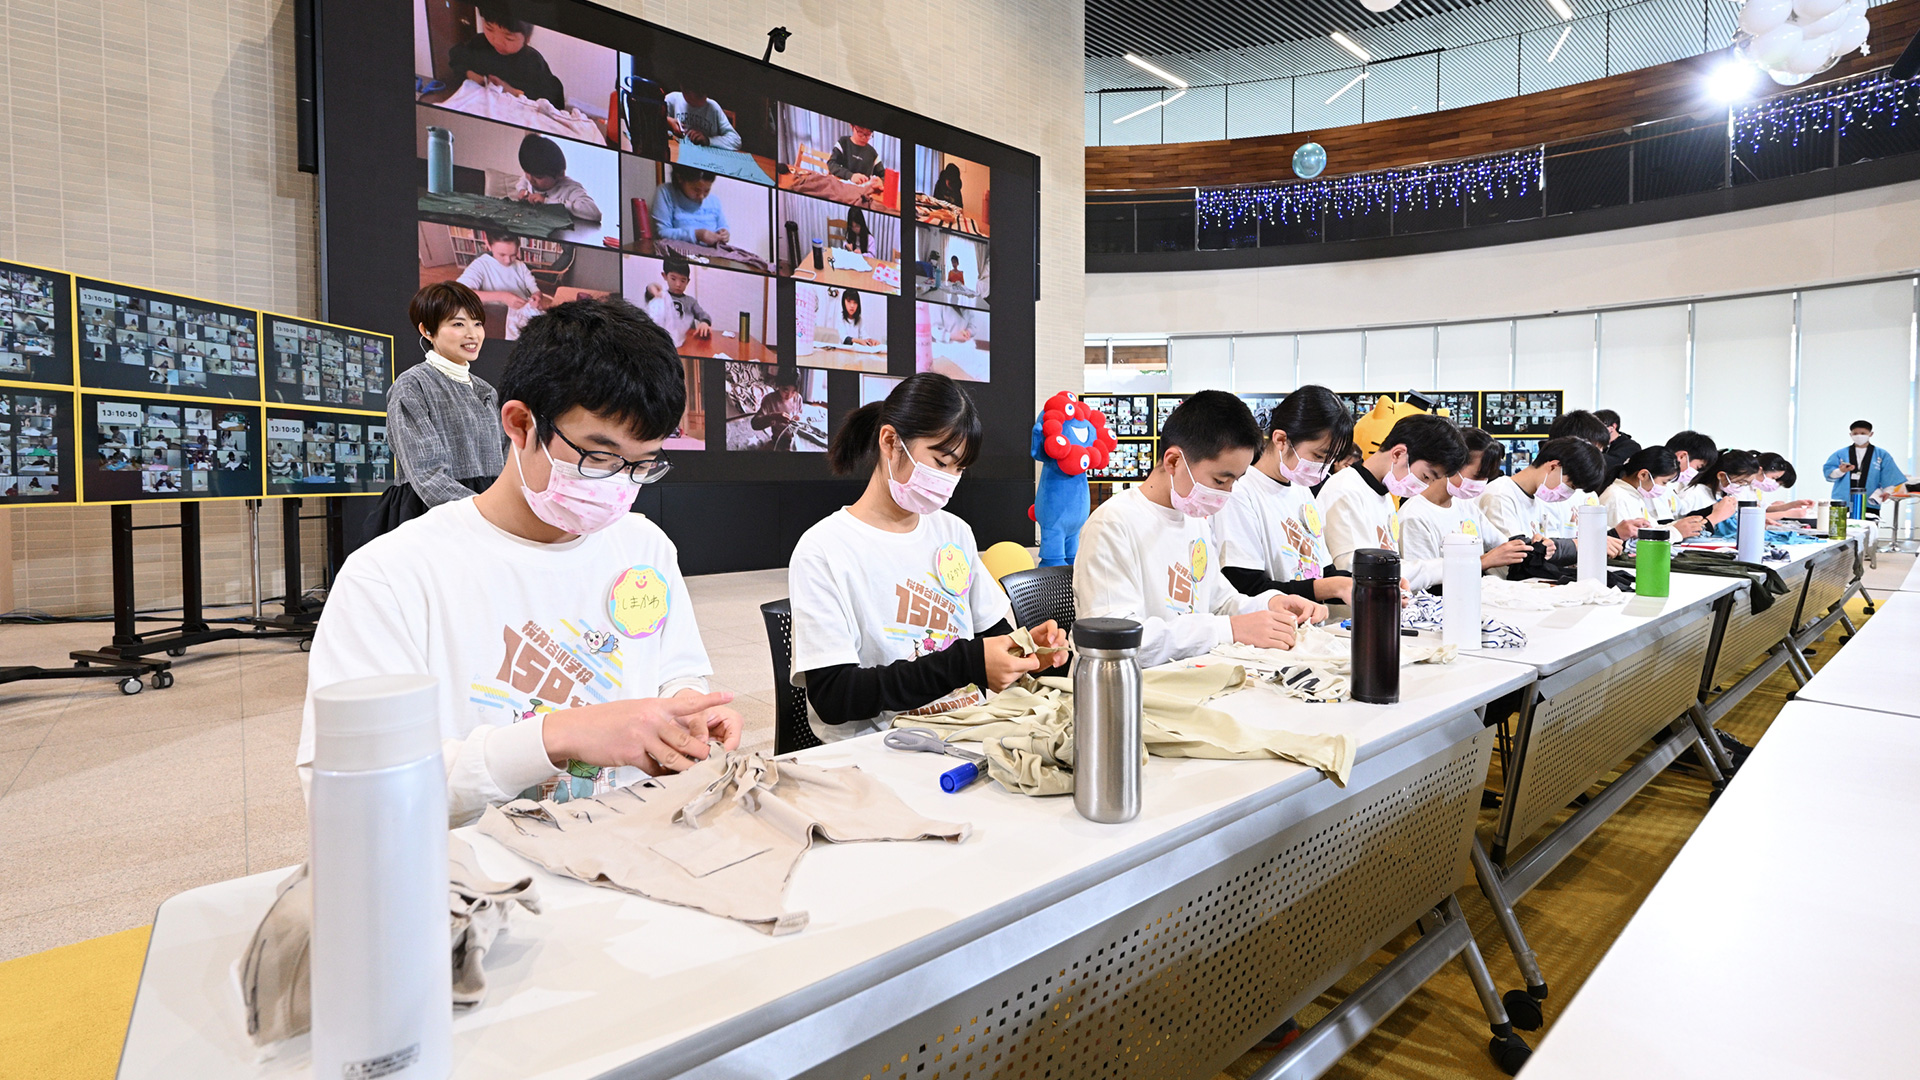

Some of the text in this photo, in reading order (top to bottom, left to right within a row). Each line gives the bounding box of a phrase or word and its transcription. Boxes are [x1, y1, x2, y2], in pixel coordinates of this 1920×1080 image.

[83, 293, 112, 304] 13:10:50
[275, 326, 297, 334] 13:10:50
[102, 409, 138, 418] 13:10:50
[271, 425, 301, 434] 13:10:50
[622, 593, 660, 610] しまかわ
